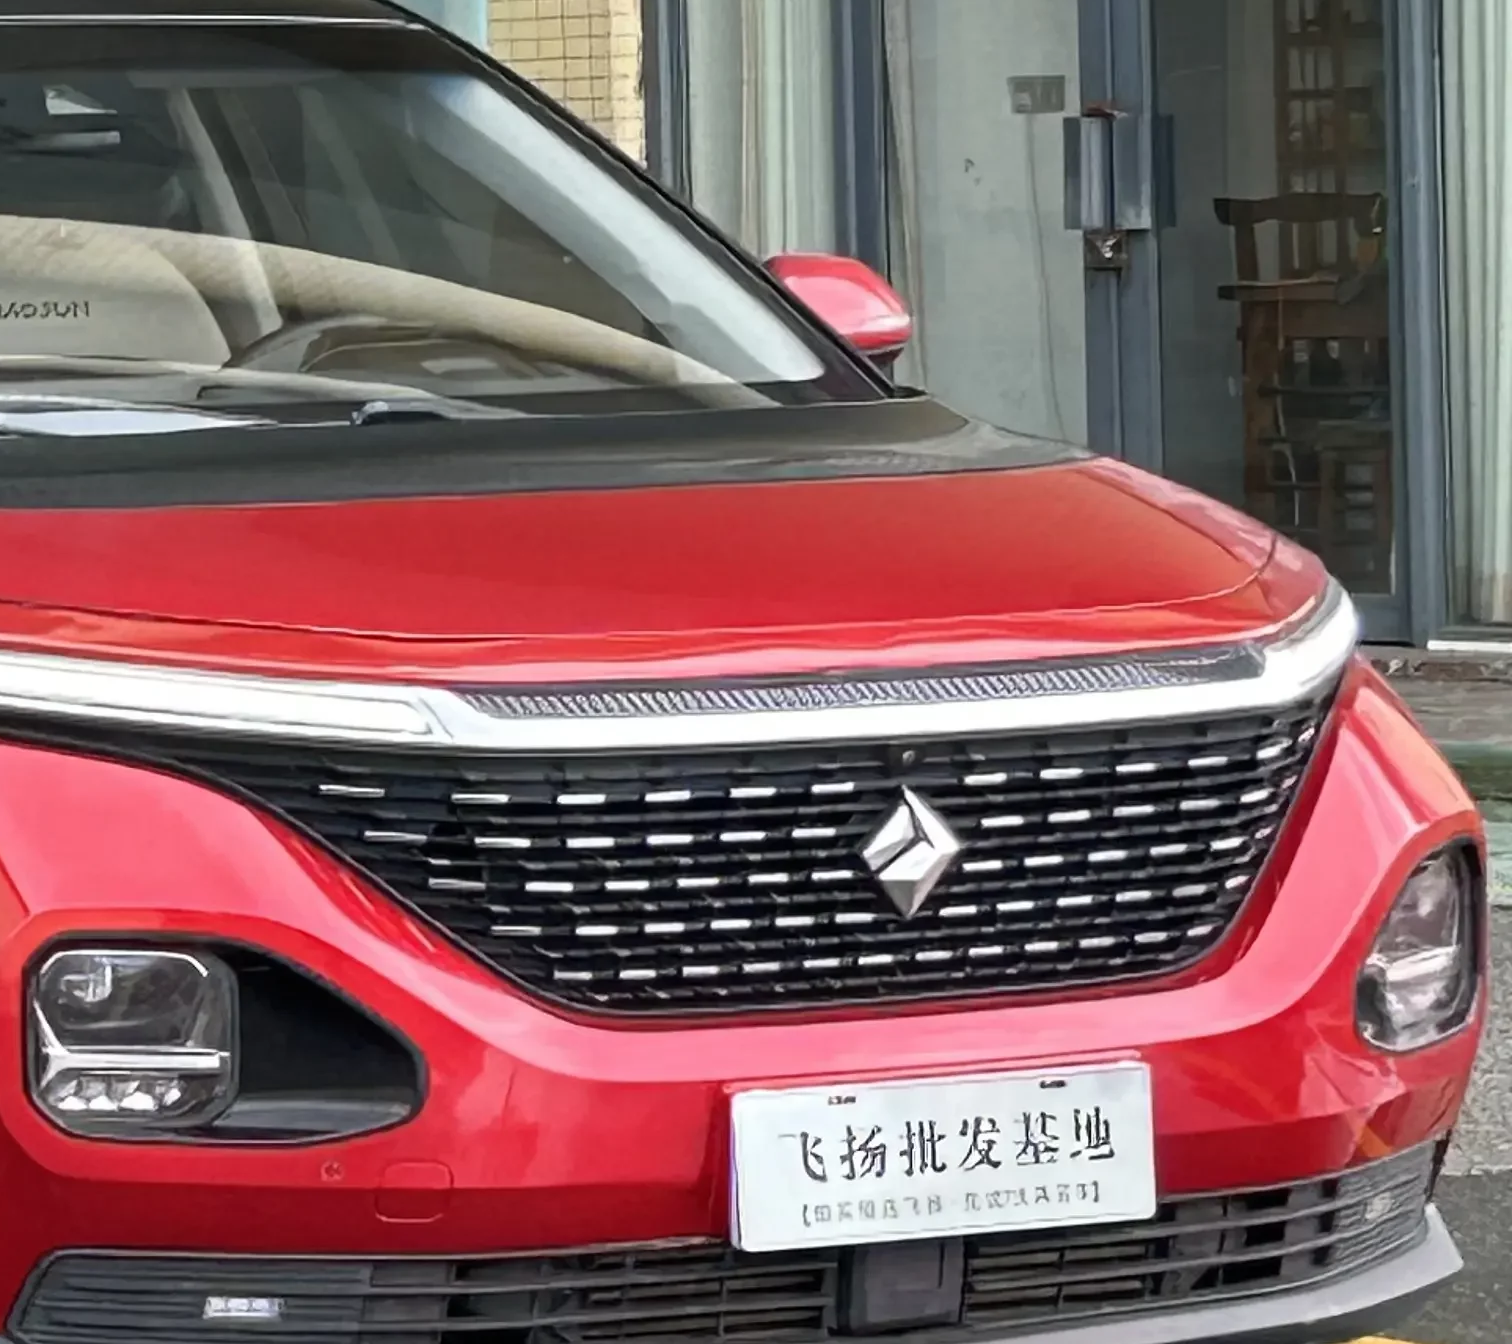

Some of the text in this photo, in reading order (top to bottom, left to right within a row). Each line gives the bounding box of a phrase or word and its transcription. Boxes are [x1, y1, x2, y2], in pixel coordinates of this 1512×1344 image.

[778, 1105, 1117, 1183] 飞扬批发基地
